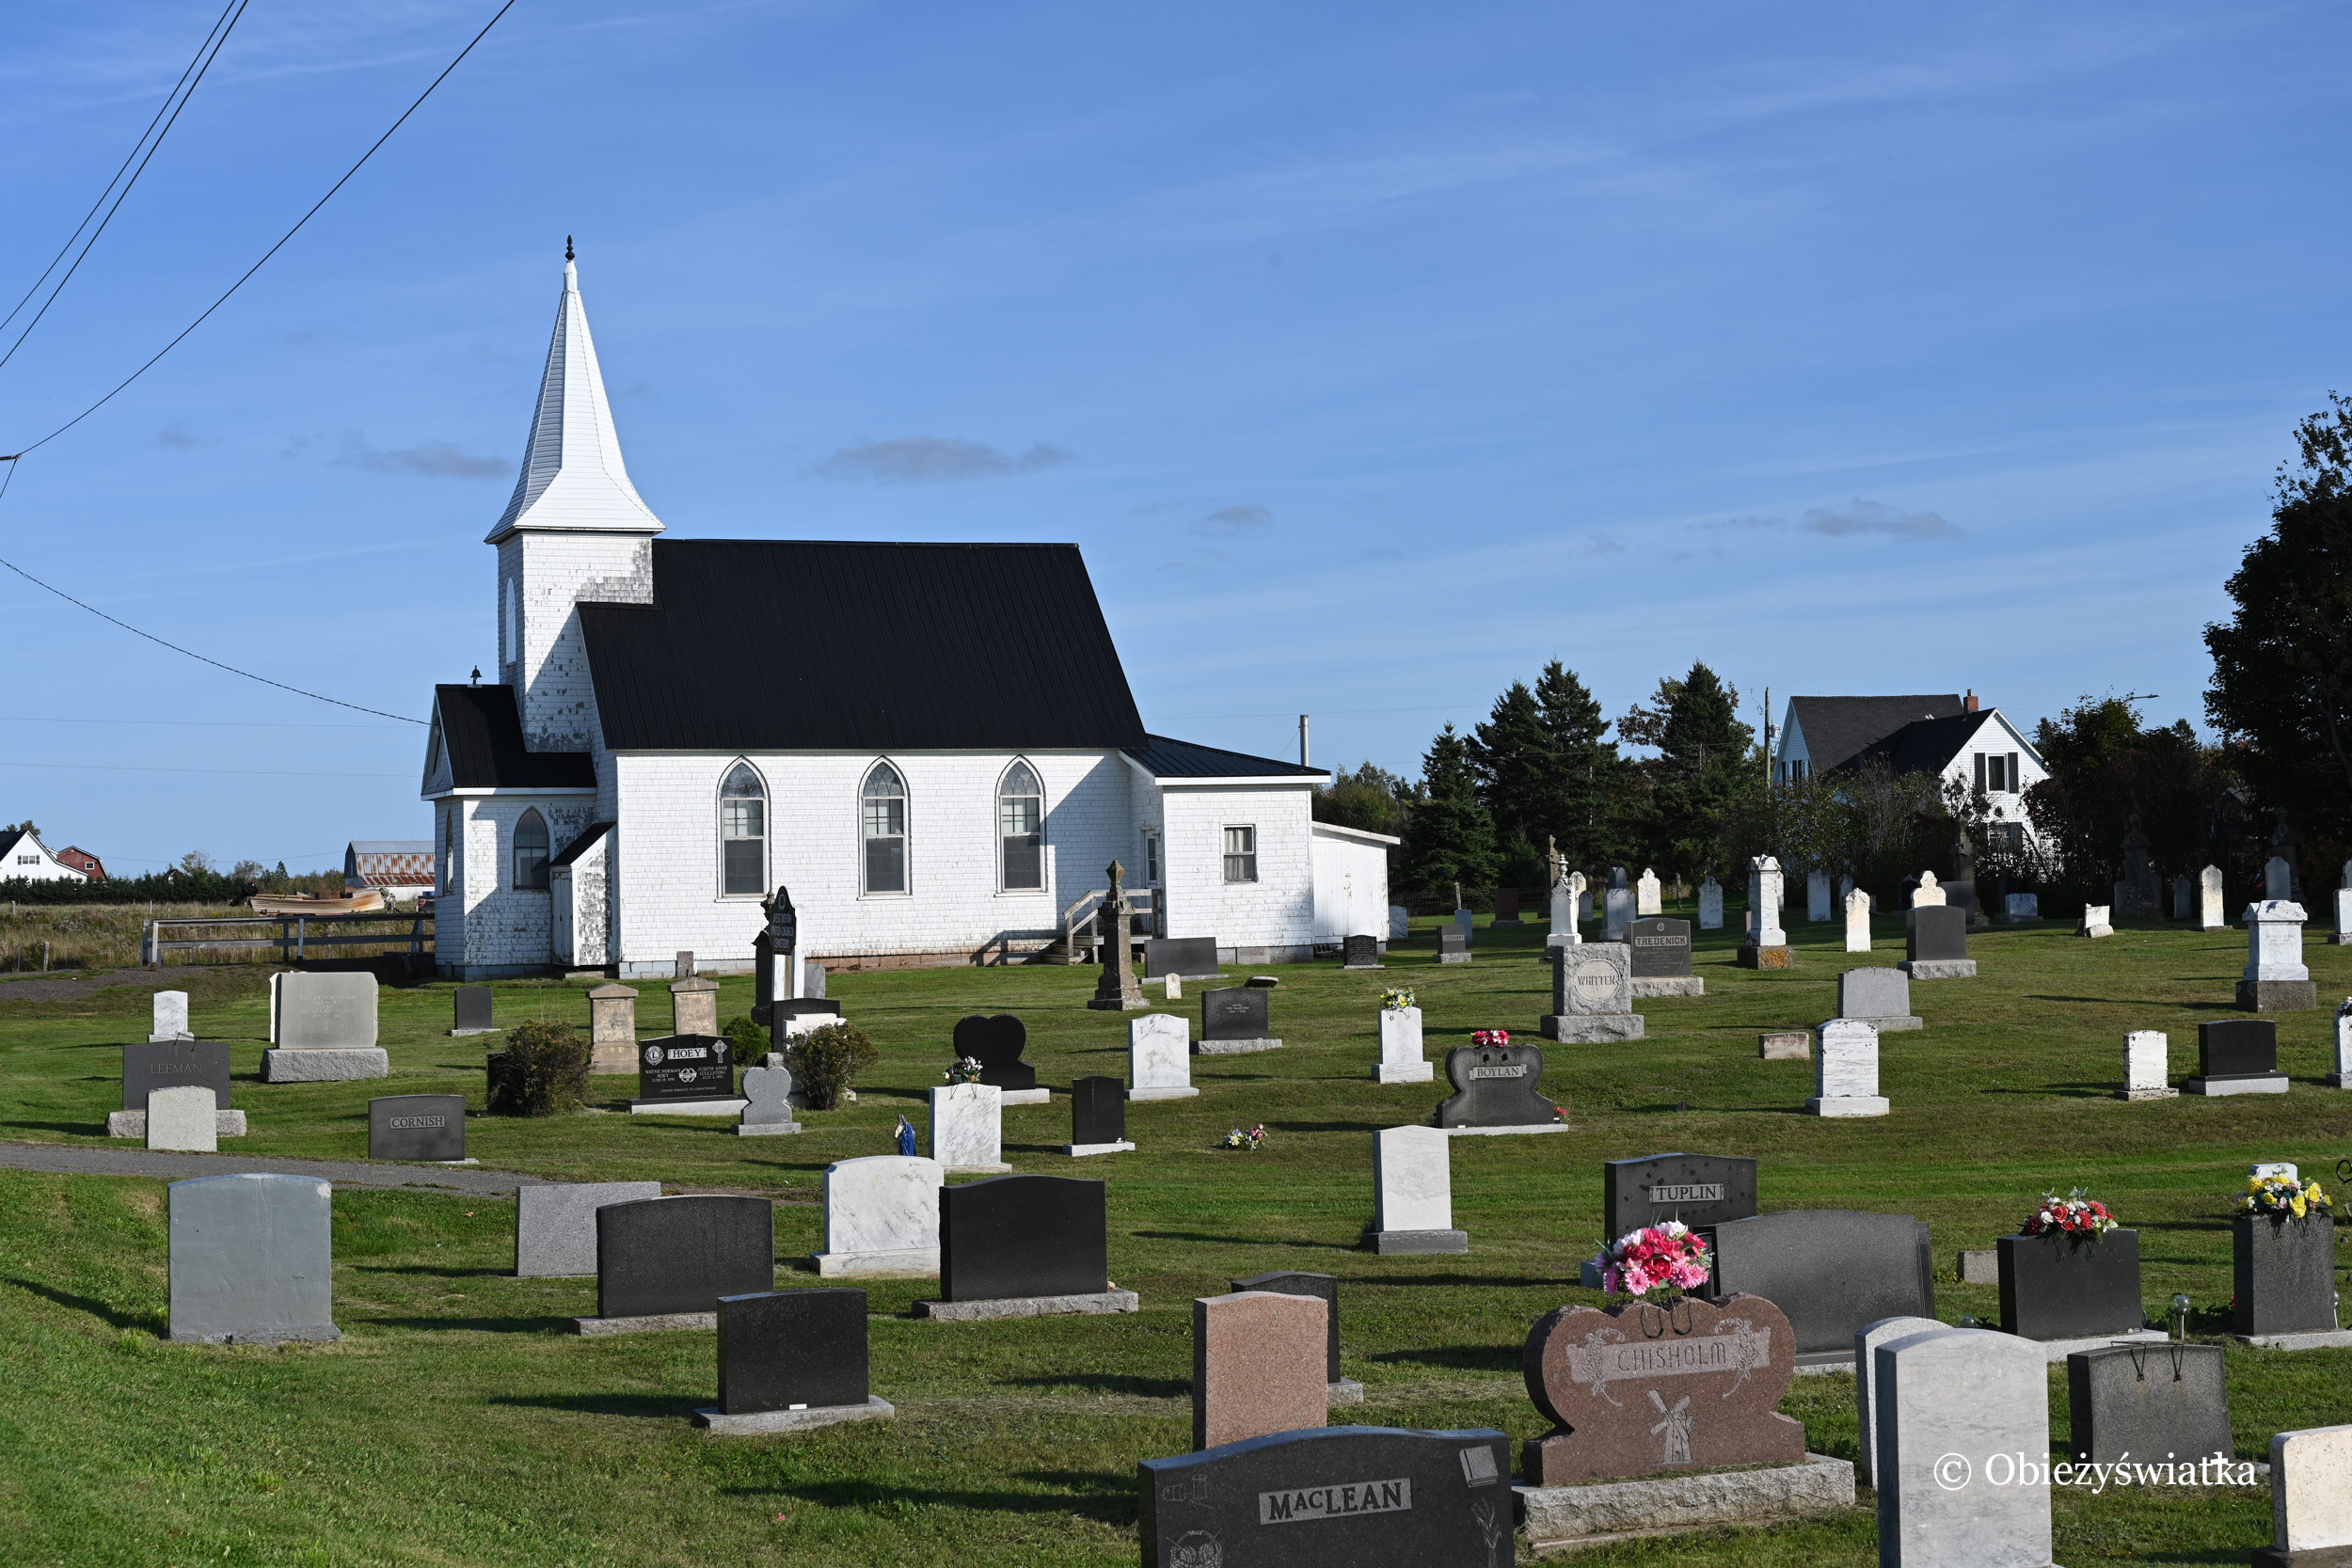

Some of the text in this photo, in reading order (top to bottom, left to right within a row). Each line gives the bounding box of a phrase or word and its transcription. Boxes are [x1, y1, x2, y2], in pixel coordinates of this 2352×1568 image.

[1636, 936, 1686, 946] TREDENICK
[1578, 974, 1615, 986] WHITTEN
[673, 1049, 702, 1058] HOEY
[151, 1063, 203, 1074] LEEMAN
[1477, 1067, 1519, 1077] BOYLAN
[391, 1117, 444, 1128] CORNISH
[1656, 1185, 1717, 1200] TUPLIN
[1617, 1341, 1727, 1371] CHISHOLM
